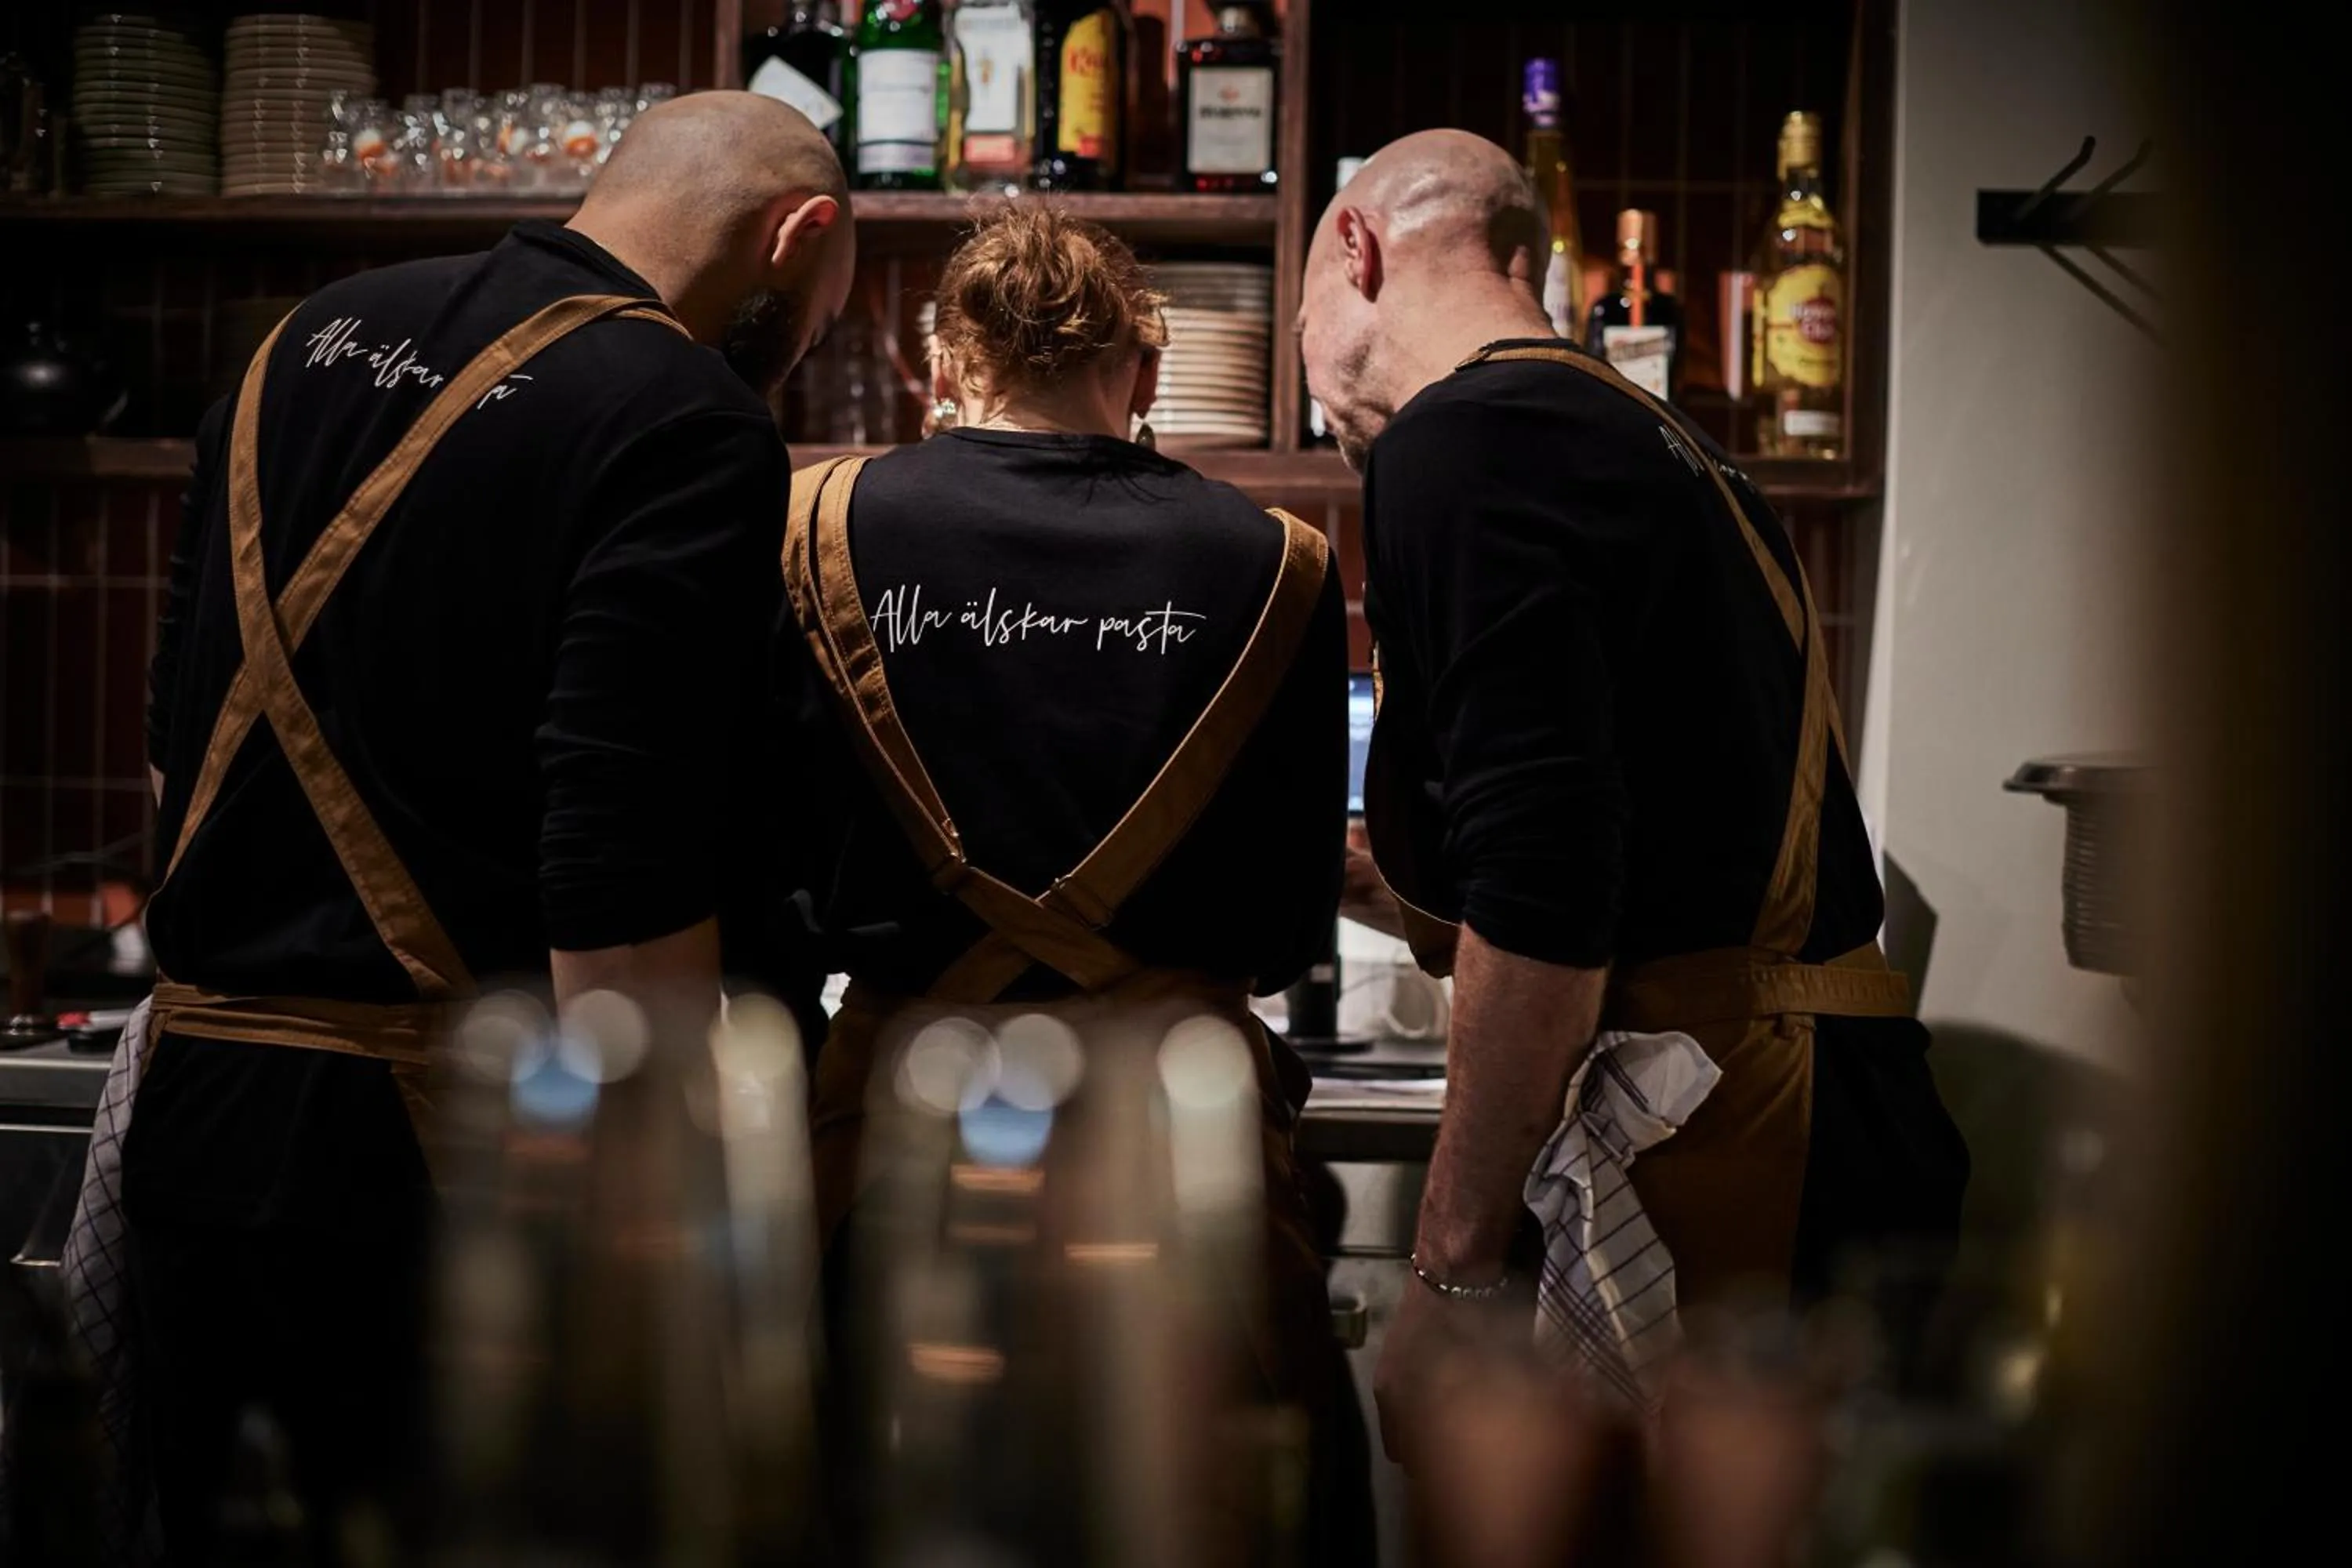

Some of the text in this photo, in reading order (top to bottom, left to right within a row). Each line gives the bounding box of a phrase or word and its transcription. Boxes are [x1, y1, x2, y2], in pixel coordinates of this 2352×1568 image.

[306, 317, 445, 389] Alla älskar
[870, 584, 1207, 655] Alla älskar pasta
